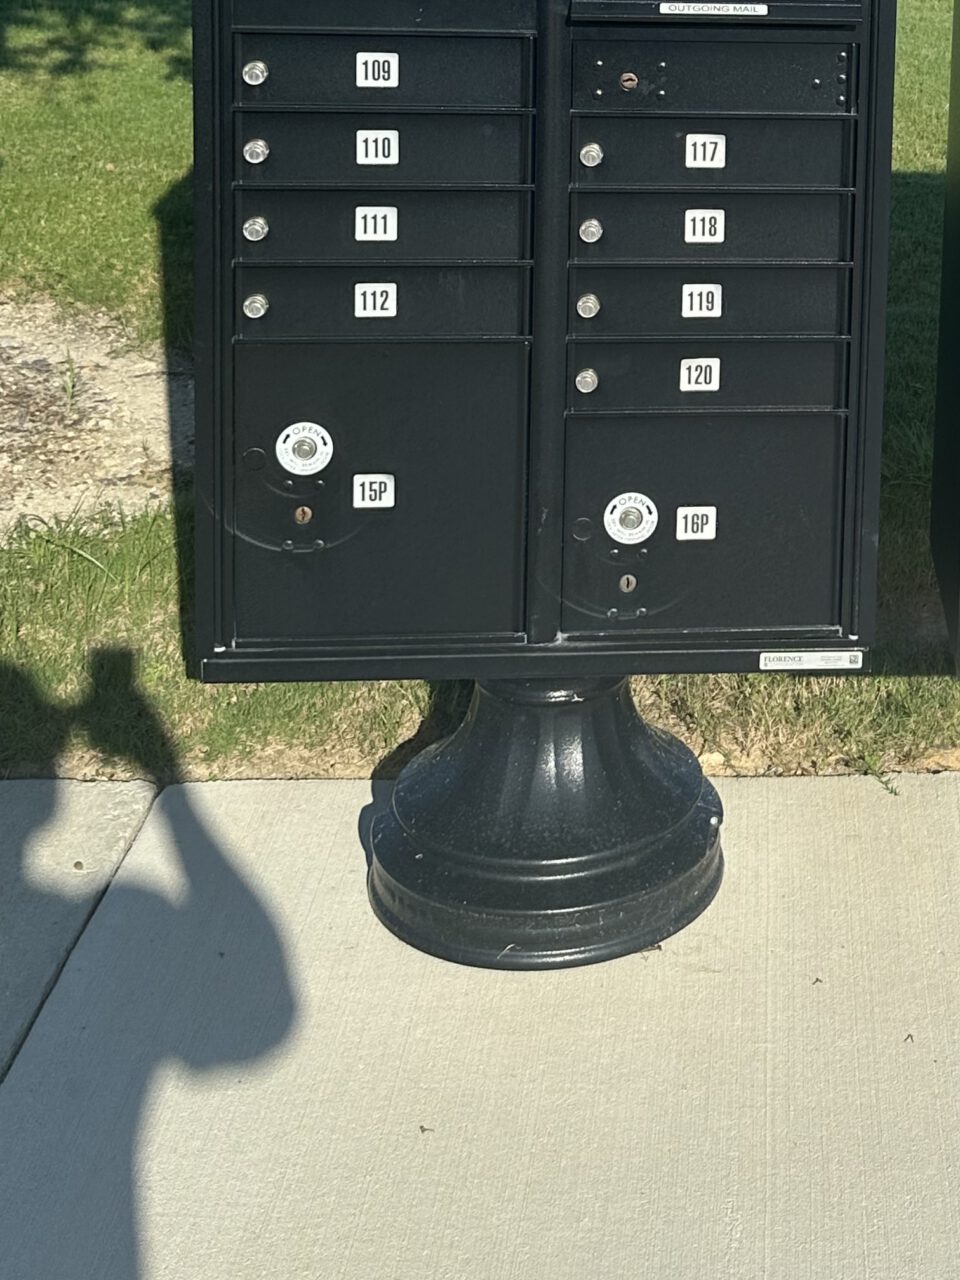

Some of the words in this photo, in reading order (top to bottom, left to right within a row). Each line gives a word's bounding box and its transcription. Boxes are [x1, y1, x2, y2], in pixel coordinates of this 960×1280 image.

[668, 4, 730, 13] OUTGOING
[733, 6, 759, 14] MAIL
[361, 59, 391, 82] 109
[362, 136, 391, 159] 110
[691, 141, 719, 162] 117
[361, 213, 388, 235] 111
[690, 215, 718, 237] 118
[360, 289, 389, 312] 112
[687, 290, 715, 312] 119
[685, 364, 713, 385] 120
[292, 425, 322, 437] OPEN
[359, 480, 388, 502] 15P
[618, 496, 646, 507] OPEN
[682, 513, 709, 534] 16P
[764, 655, 803, 663] FLORENCE
